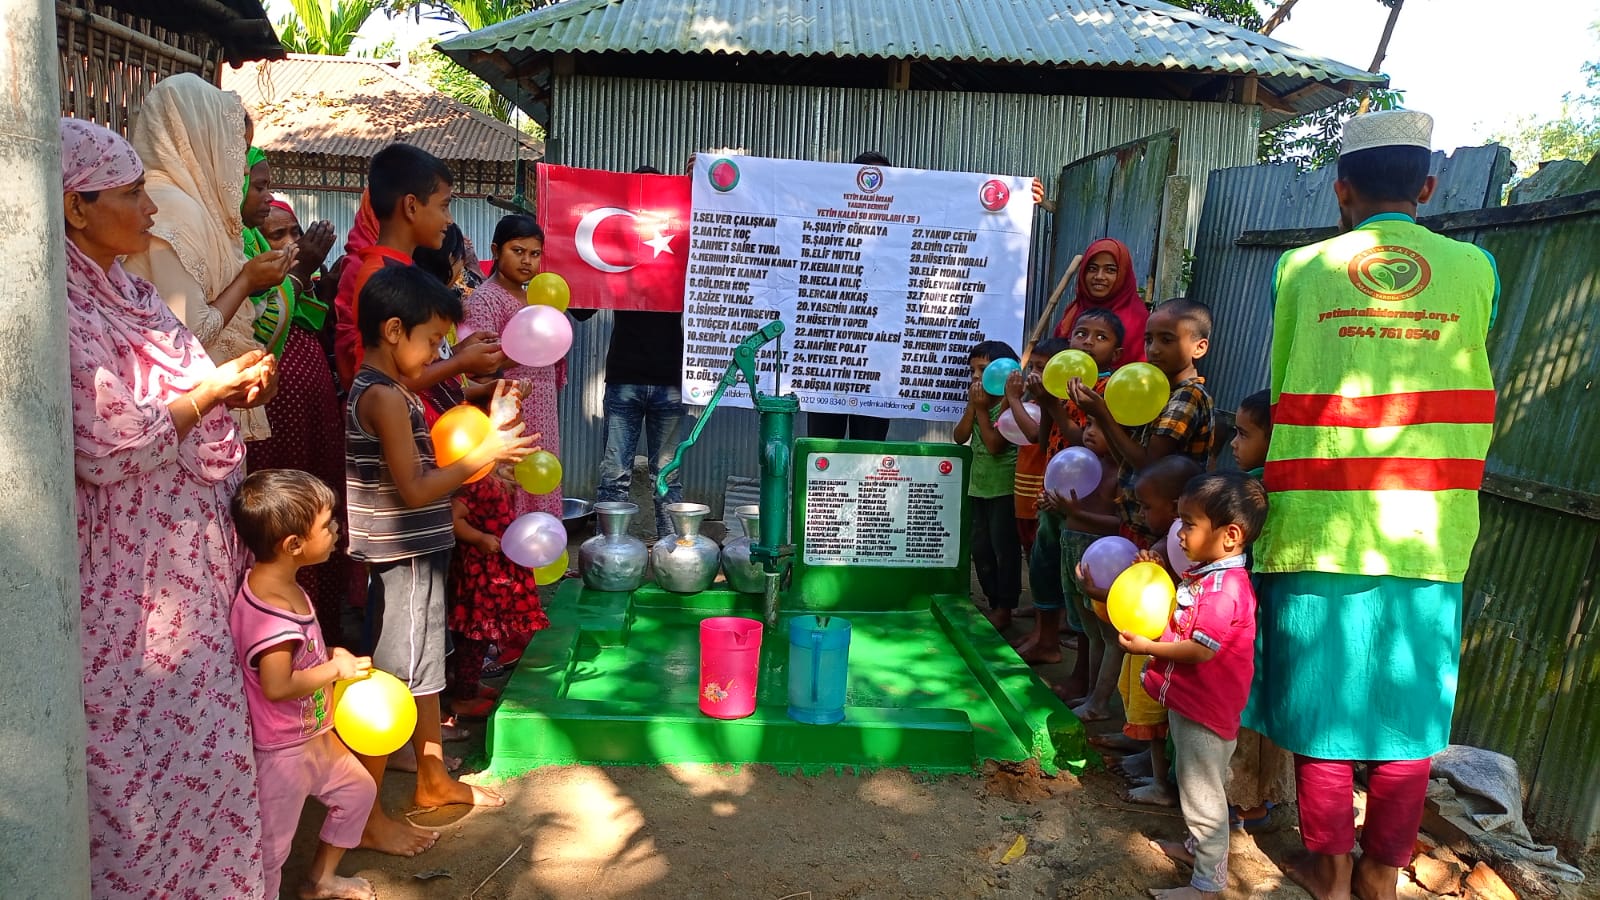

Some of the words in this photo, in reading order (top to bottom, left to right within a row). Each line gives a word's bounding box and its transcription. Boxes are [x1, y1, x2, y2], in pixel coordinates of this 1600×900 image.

[693, 212, 732, 224] 1.SELVER
[733, 215, 777, 228] ÇALIŞKAN
[817, 207, 837, 217] YETİM
[837, 210, 857, 218] KALBİ
[868, 212, 900, 222] KUYULARI
[692, 225, 731, 238] 2.HATİCE
[732, 228, 750, 241] KOÇ
[802, 220, 846, 234] 14.ŞUAYİP
[847, 222, 887, 236] GÖKKAYA
[911, 228, 951, 239] 27.YAKUP
[691, 239, 729, 251] 3.AHMET
[758, 244, 779, 254] TURA
[801, 233, 844, 247] 15.ŞADİYE
[844, 237, 862, 247] ALP
[910, 240, 942, 252] 28.EMİR
[730, 253, 770, 266] SÜLEYMAN
[770, 258, 797, 268] KANAT
[800, 246, 830, 258] 16.ELİF
[831, 249, 860, 261] MUTLU
[909, 252, 956, 265] 29.HÜSEYİN
[957, 256, 988, 267] MORALİ
[690, 264, 736, 276] 5.HAMDİYE
[737, 268, 768, 279] KANAT
[800, 261, 840, 273] 17.KENAN
[841, 263, 863, 276] KILIÇ
[908, 265, 938, 276] 30.ELİF
[939, 267, 970, 278] MORALİ
[689, 276, 731, 289] 6.GÜLDEN
[731, 280, 750, 293] KOÇ
[799, 274, 837, 286] 18.NECLA
[838, 277, 861, 289] KILIÇ
[689, 289, 721, 302] 7.AZİZE
[722, 293, 753, 304] YILMAZ
[798, 287, 837, 299] 19.ERCAN
[838, 290, 868, 303] AKKAŞ
[796, 301, 847, 313] 20.YASEMİN
[848, 305, 878, 317] AKKAŞ
[1318, 308, 1460, 322] yetimkalbidernegi.org.tr
[795, 313, 840, 326] 21.HÜSEYİN
[842, 317, 867, 328] TOPER
[687, 330, 726, 343] 10.SERPİL
[794, 327, 835, 338] 22.AHMET
[835, 330, 873, 340] KOYUNCU
[874, 330, 901, 343] AİLESİ
[903, 327, 948, 339] 35.MEHMET
[948, 329, 968, 340] EMİN
[1339, 326, 1375, 337] 0544
[1379, 327, 1402, 339] 761
[1405, 328, 1440, 341] 8540
[838, 342, 866, 353] POLAT
[902, 340, 947, 351] 36.MERHUM
[792, 352, 838, 364] 24.VEYSEL
[839, 356, 868, 366] POLAT
[901, 352, 937, 363] 37.EYLÜL
[685, 369, 722, 383] 13.GÜLŞA
[791, 365, 851, 378] 25.SELLATTİN
[853, 370, 880, 380] TEMUR
[900, 364, 942, 375] 38.ELSHAD
[790, 377, 831, 391] 26.BÜŞRA
[833, 381, 871, 393] KUŞTEPE
[899, 376, 934, 387] 39.ANAR
[829, 397, 846, 406] 8340
[898, 389, 941, 399] 40.ELSHAD
